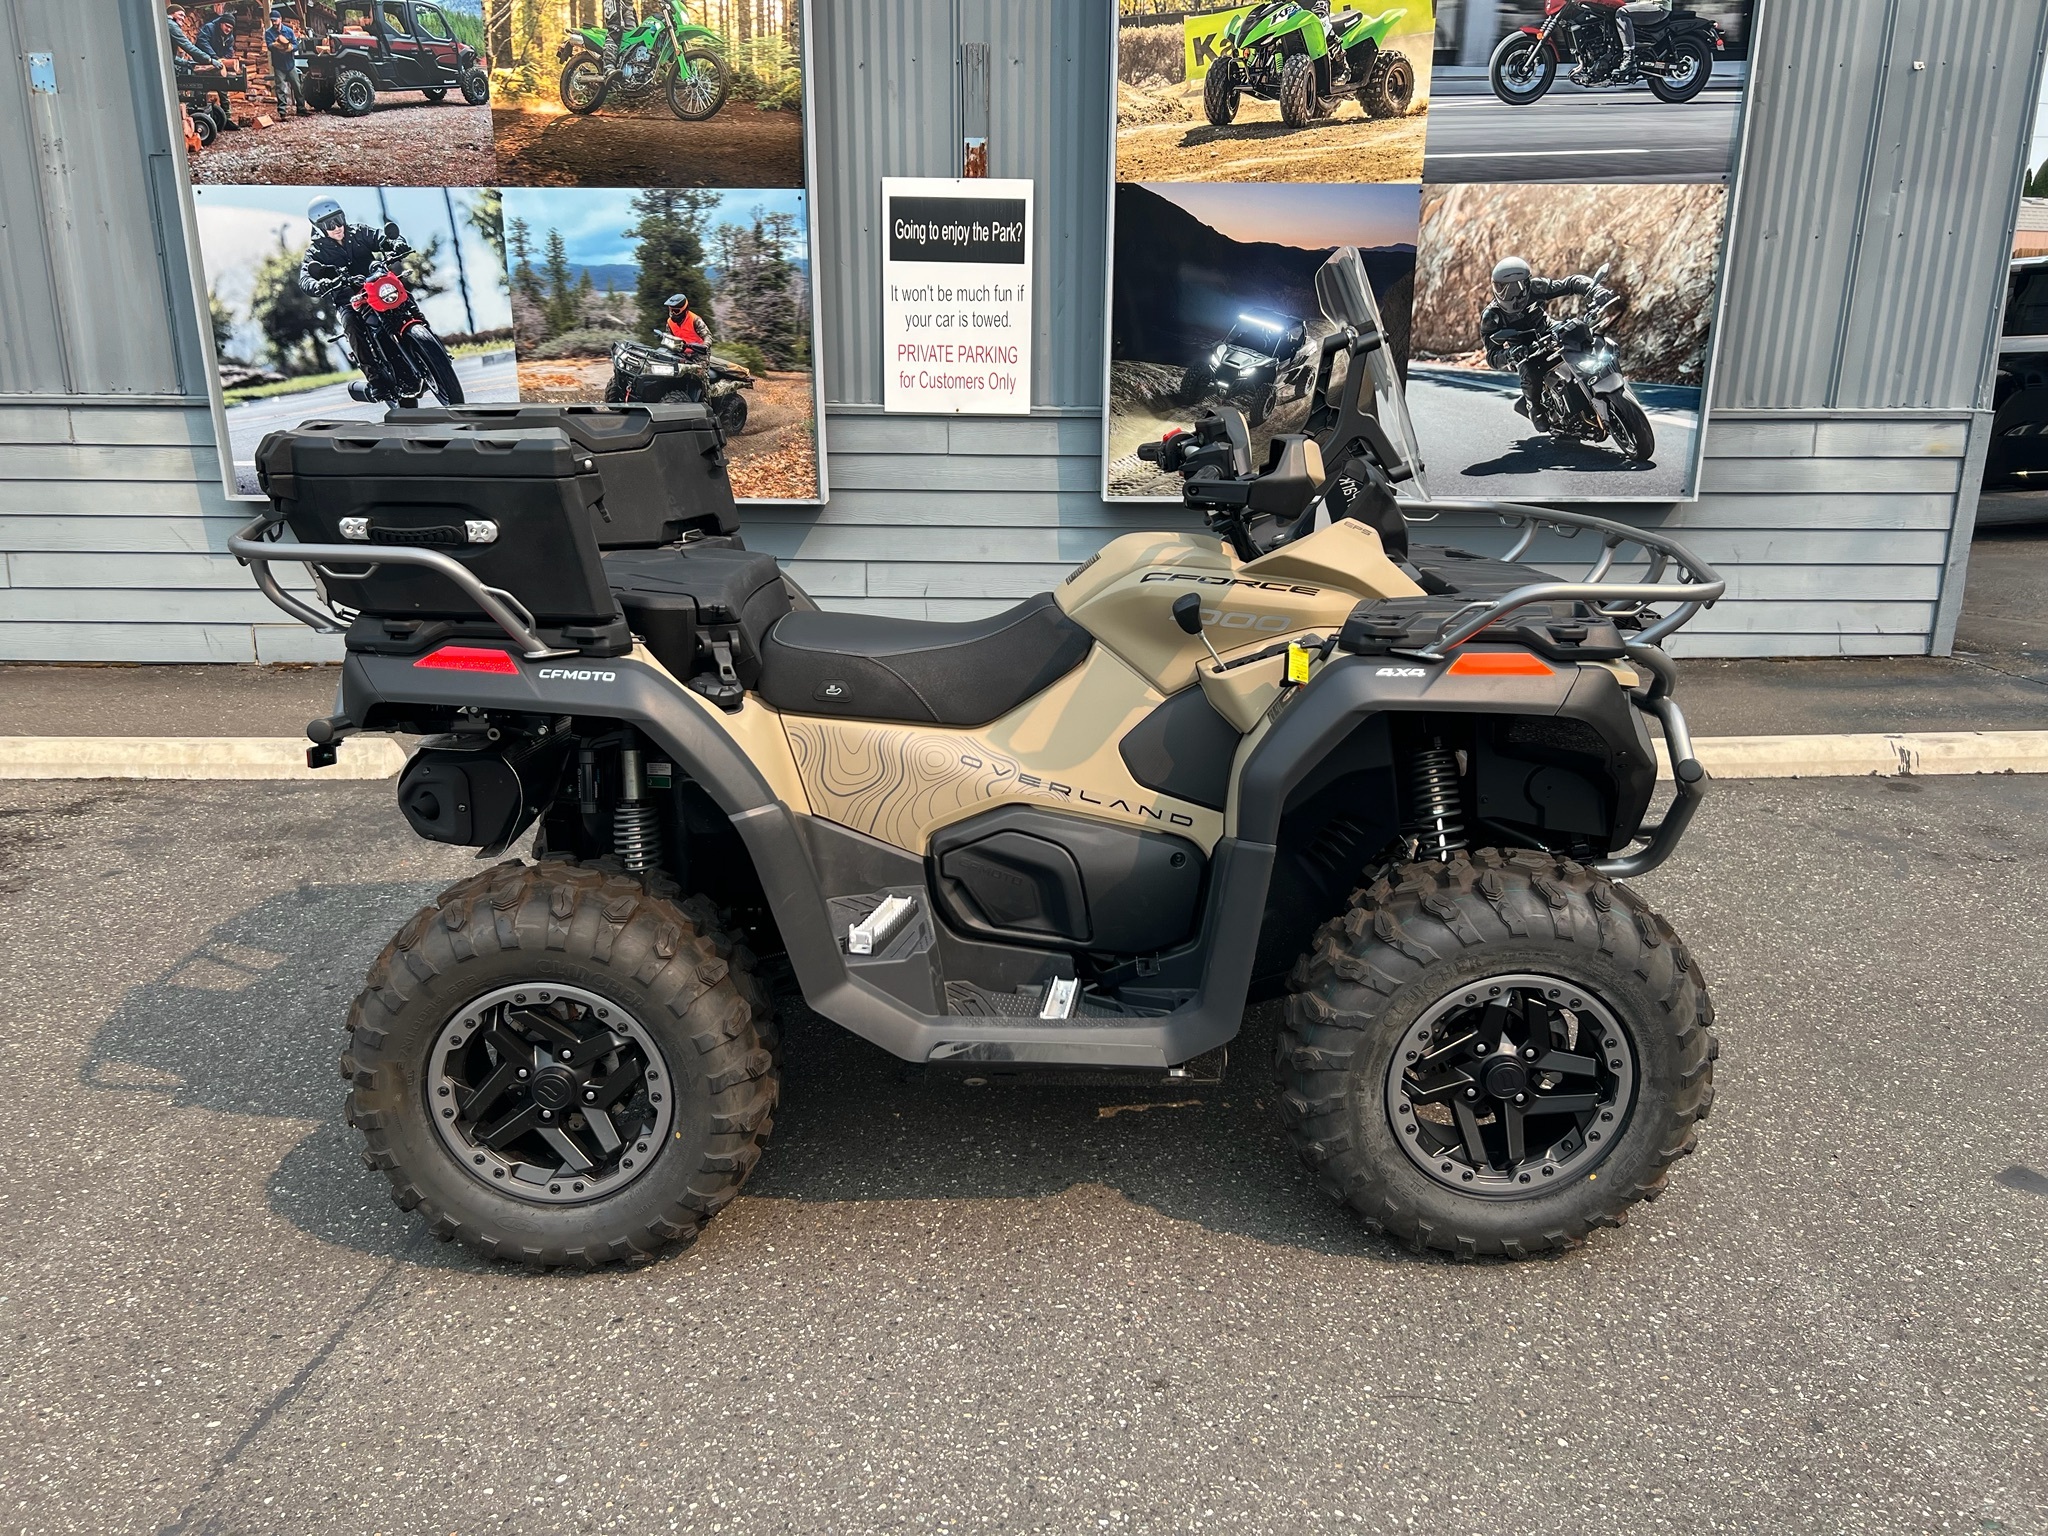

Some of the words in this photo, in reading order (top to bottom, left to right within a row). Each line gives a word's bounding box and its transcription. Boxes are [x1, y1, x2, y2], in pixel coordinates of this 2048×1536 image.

[894, 218, 926, 245] Going
[928, 220, 940, 241] to
[941, 220, 971, 246] enjoy
[972, 221, 990, 242] the
[992, 221, 1023, 242] Park?
[890, 284, 899, 302] It
[901, 284, 934, 302] won't
[937, 284, 953, 302] be
[956, 285, 990, 302] much
[994, 284, 1013, 302] fun
[1017, 284, 1025, 302] if
[904, 314, 932, 332] your
[935, 314, 954, 328] car
[958, 310, 969, 328] is
[972, 310, 1012, 328] towed.
[897, 344, 954, 363] PRIVATE
[958, 345, 1018, 364] PARKING
[899, 370, 916, 389] for
[919, 370, 985, 390] Customers
[988, 371, 1017, 395] Only
[1343, 520, 1373, 536] EPS
[1139, 571, 1321, 597] CFORCE
[538, 668, 617, 682] CFMOTO
[960, 754, 1194, 828] OVERLAND
